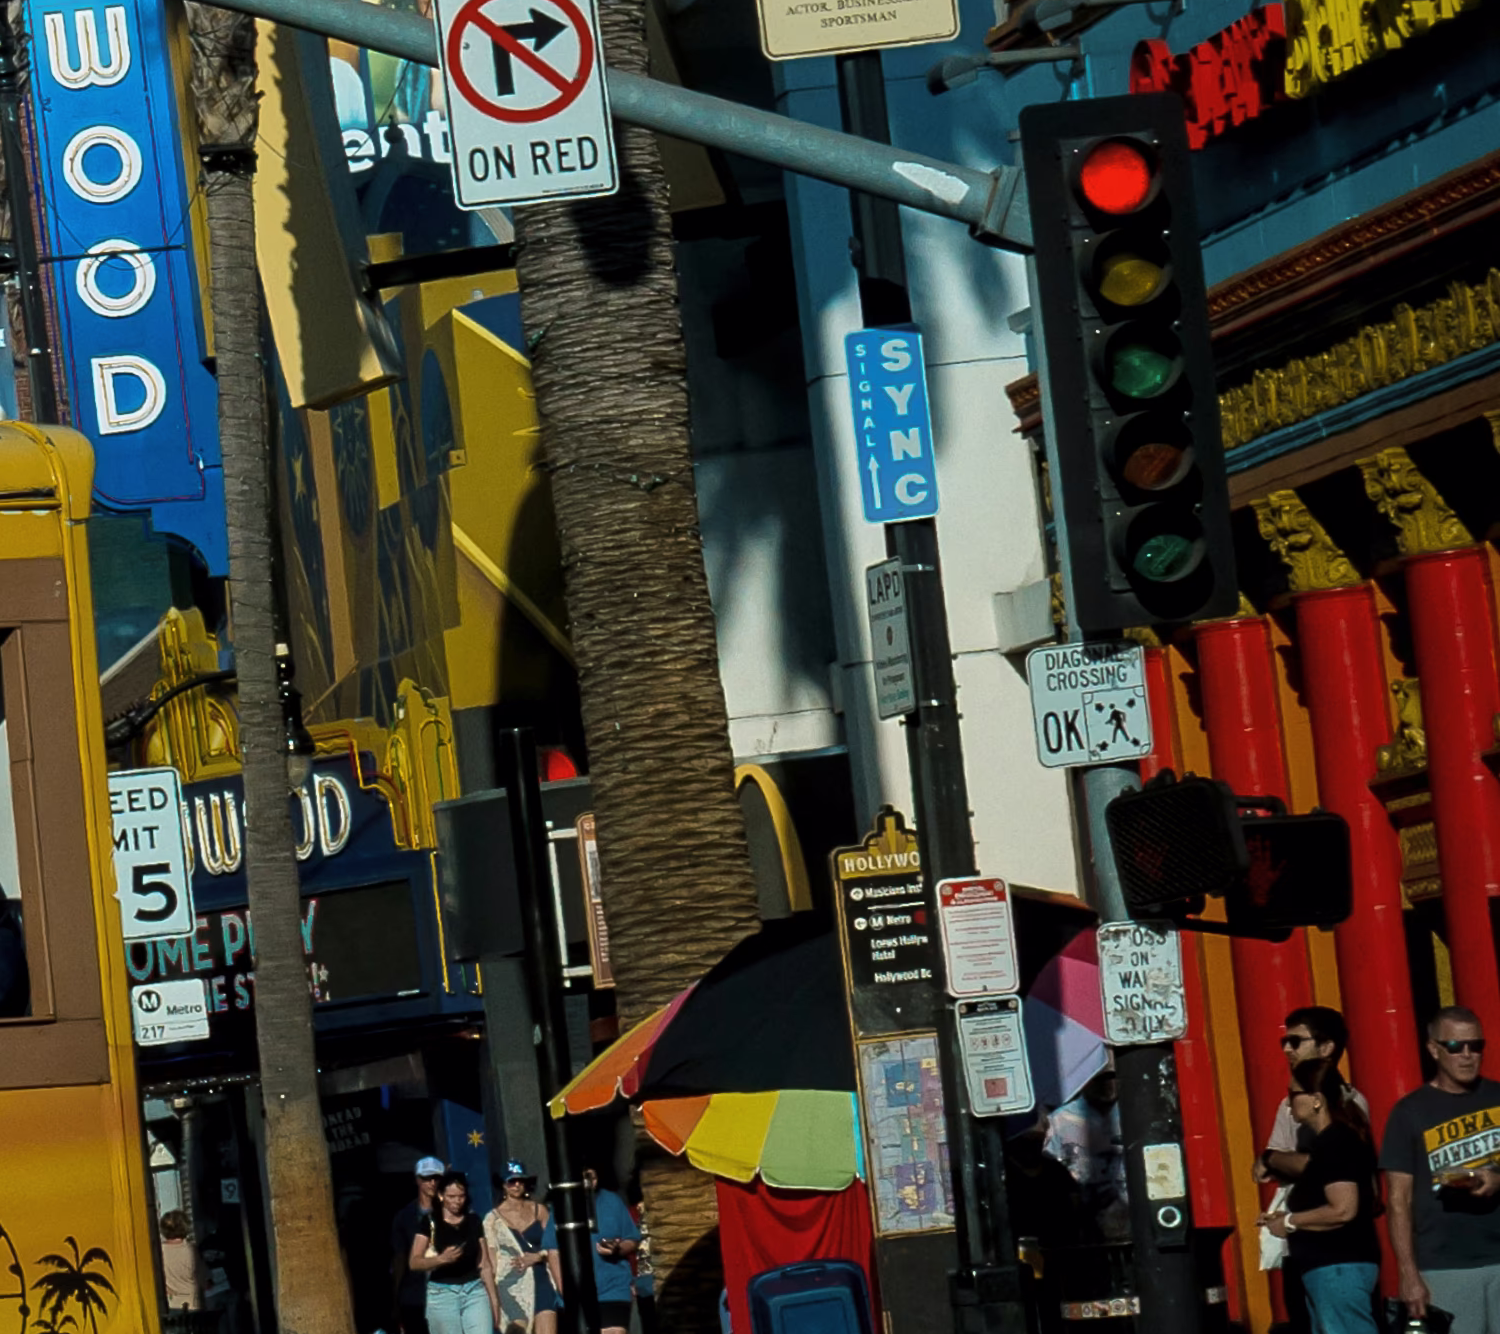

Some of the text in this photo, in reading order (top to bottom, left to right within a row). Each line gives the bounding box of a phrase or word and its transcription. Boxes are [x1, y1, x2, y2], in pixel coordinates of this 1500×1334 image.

[820, 10, 897, 28] SPORTSMAN
[469, 136, 598, 183] ON RED
[855, 344, 877, 448] SIGNAL
[880, 339, 928, 505] SYNC
[868, 571, 900, 605] LAPD
[1046, 664, 1127, 691] CROSSING
[1043, 709, 1085, 754] OK
[132, 862, 177, 922] 5
[886, 915, 912, 925] Metro
[1130, 952, 1149, 967] ON
[166, 1003, 202, 1016] Metro
[141, 1025, 165, 1039] 217
